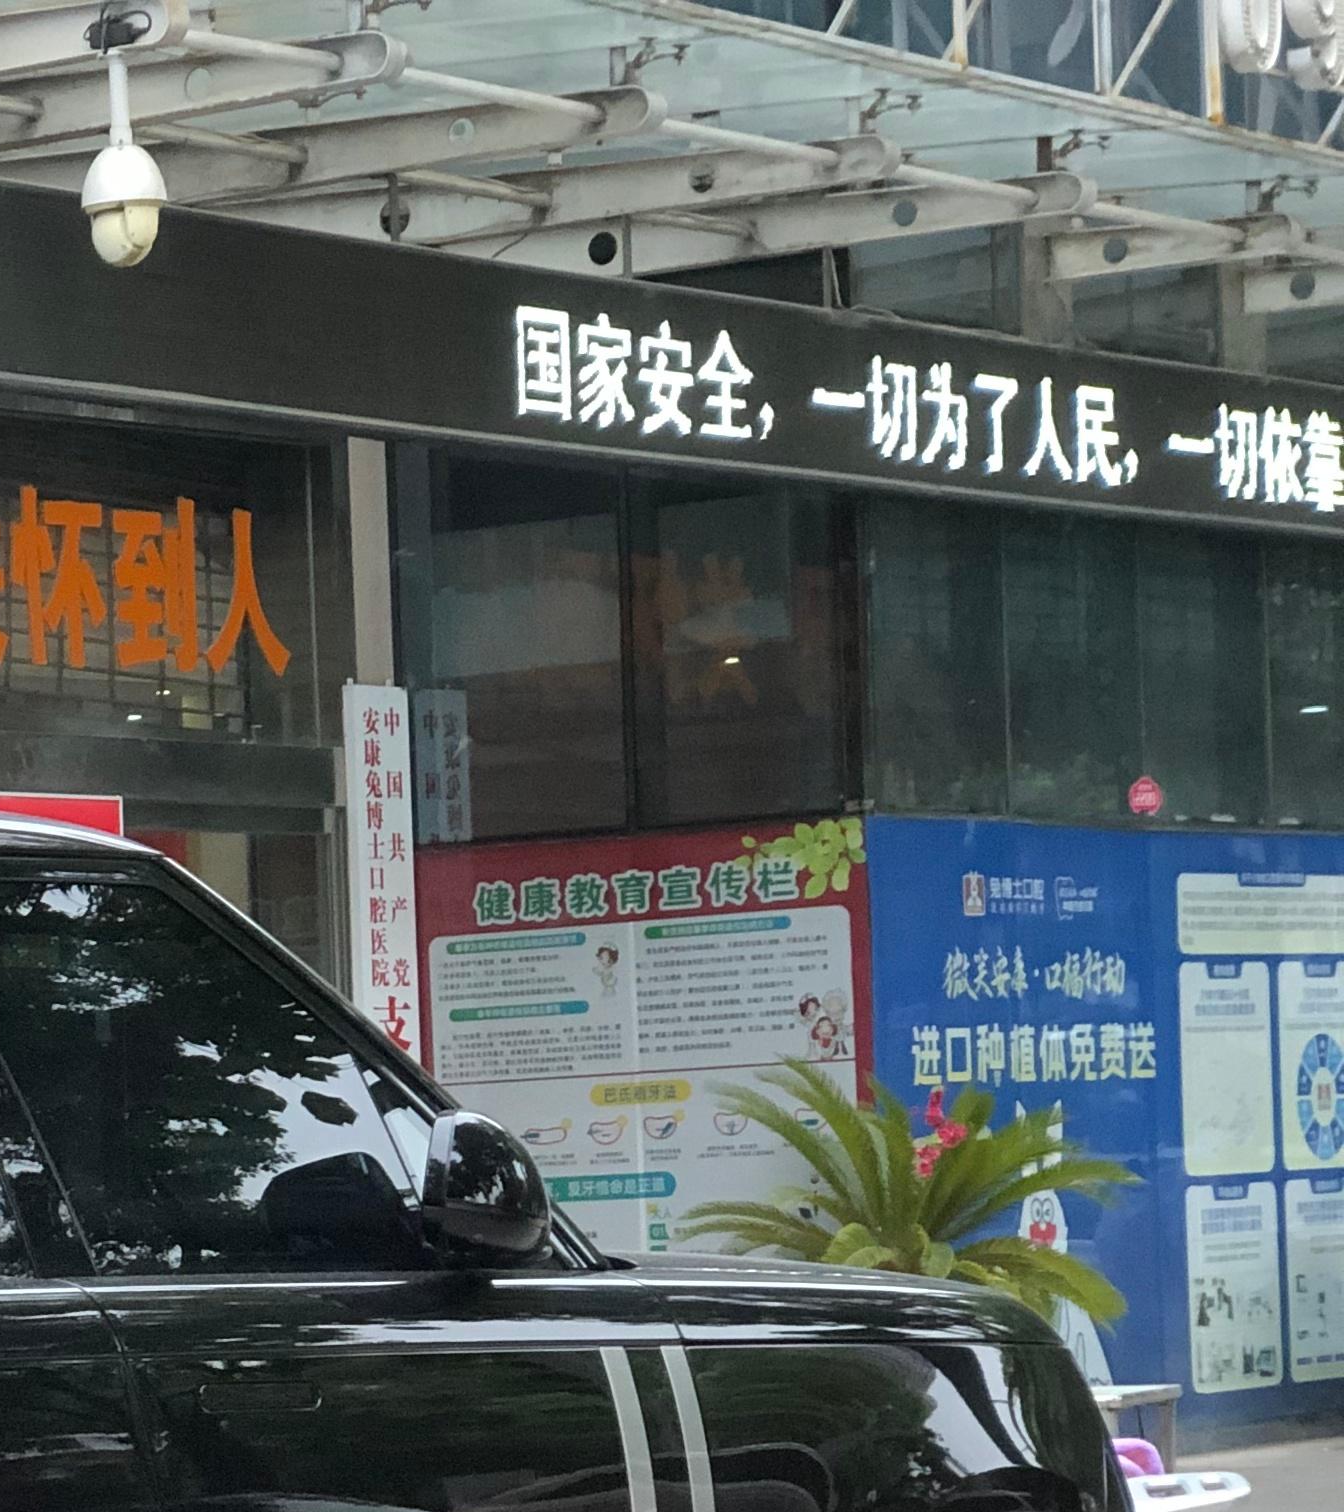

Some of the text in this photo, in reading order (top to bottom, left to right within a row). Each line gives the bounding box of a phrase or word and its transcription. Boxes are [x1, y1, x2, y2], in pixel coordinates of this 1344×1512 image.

[362, 707, 390, 988] 安康兔博士口腔医院
[384, 707, 411, 988] 中国共产党
[473, 859, 801, 927] 健康教育宣传栏
[912, 1022, 1157, 1087] 进口种植体免费送
